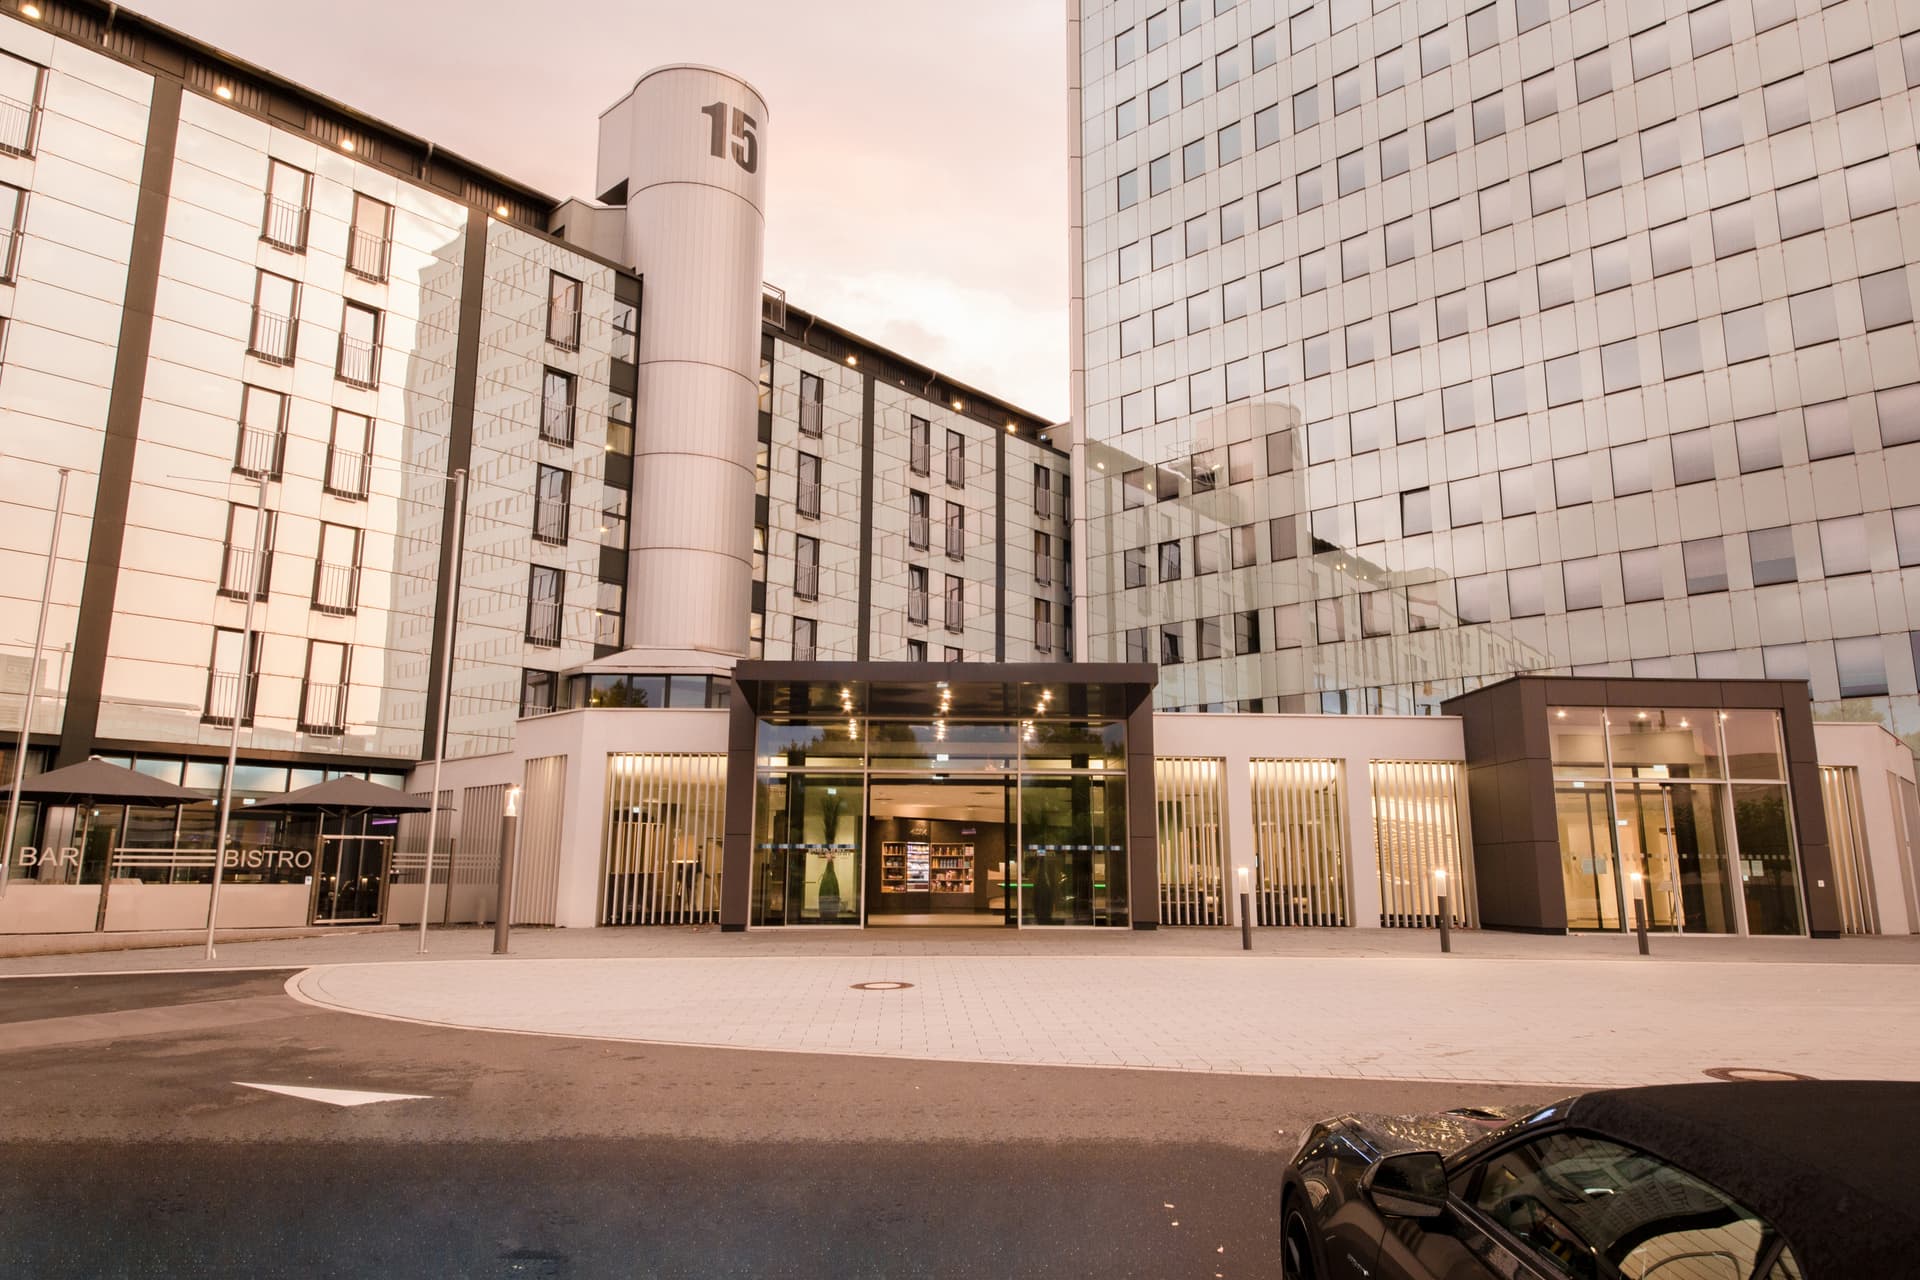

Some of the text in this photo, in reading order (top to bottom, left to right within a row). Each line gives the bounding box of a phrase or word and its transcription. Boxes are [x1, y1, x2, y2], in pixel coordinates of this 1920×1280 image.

[701, 101, 758, 174] 15
[18, 846, 80, 867] BAR
[223, 849, 313, 868] BISTRO
